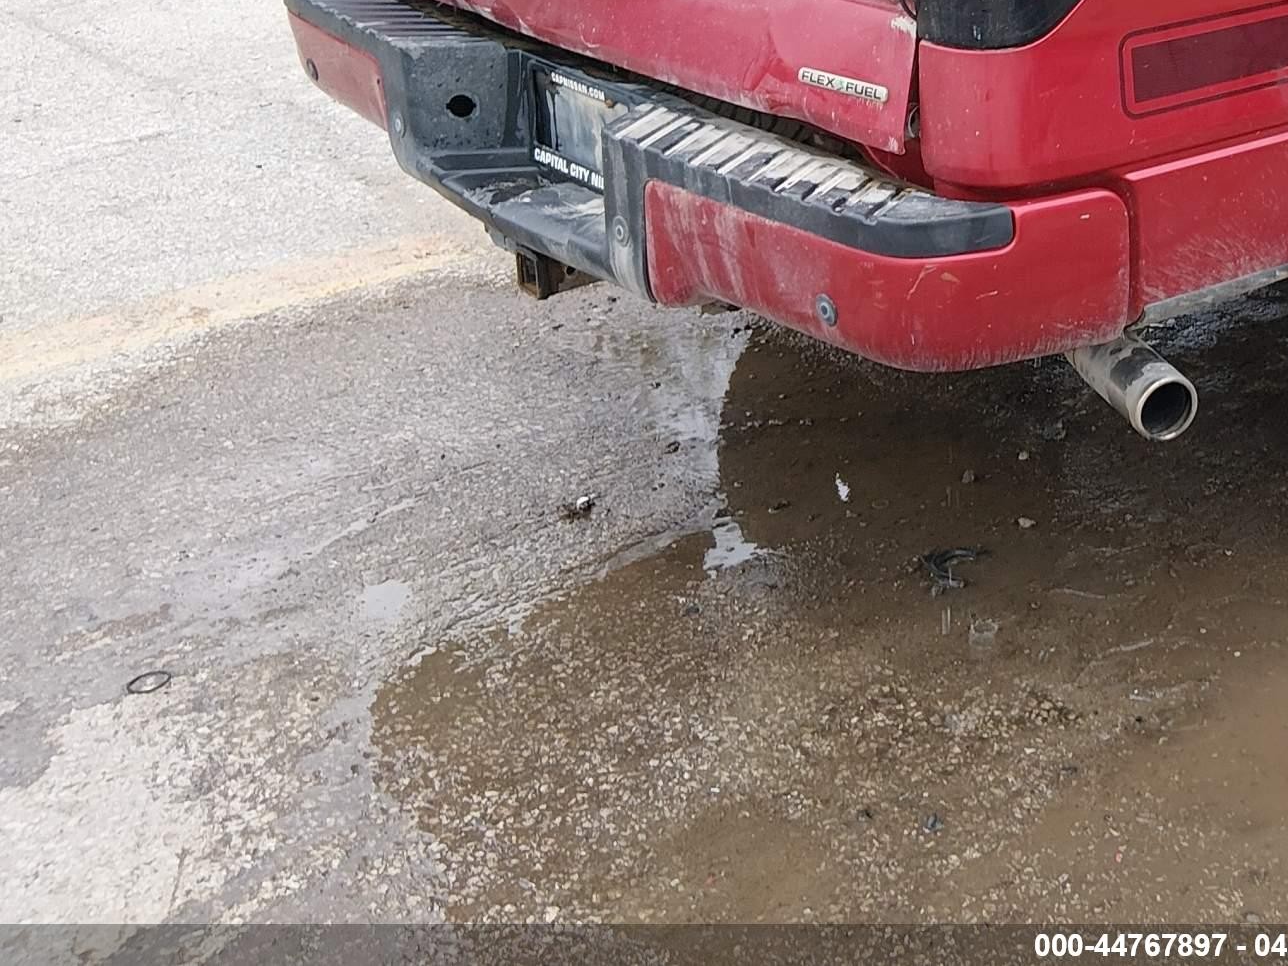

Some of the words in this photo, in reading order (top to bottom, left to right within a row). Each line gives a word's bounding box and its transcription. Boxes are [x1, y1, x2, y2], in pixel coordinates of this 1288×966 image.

[801, 70, 836, 88] FLEX
[846, 81, 882, 100] FUEL
[534, 147, 569, 174] CAPITAL
[569, 163, 590, 183] CITY
